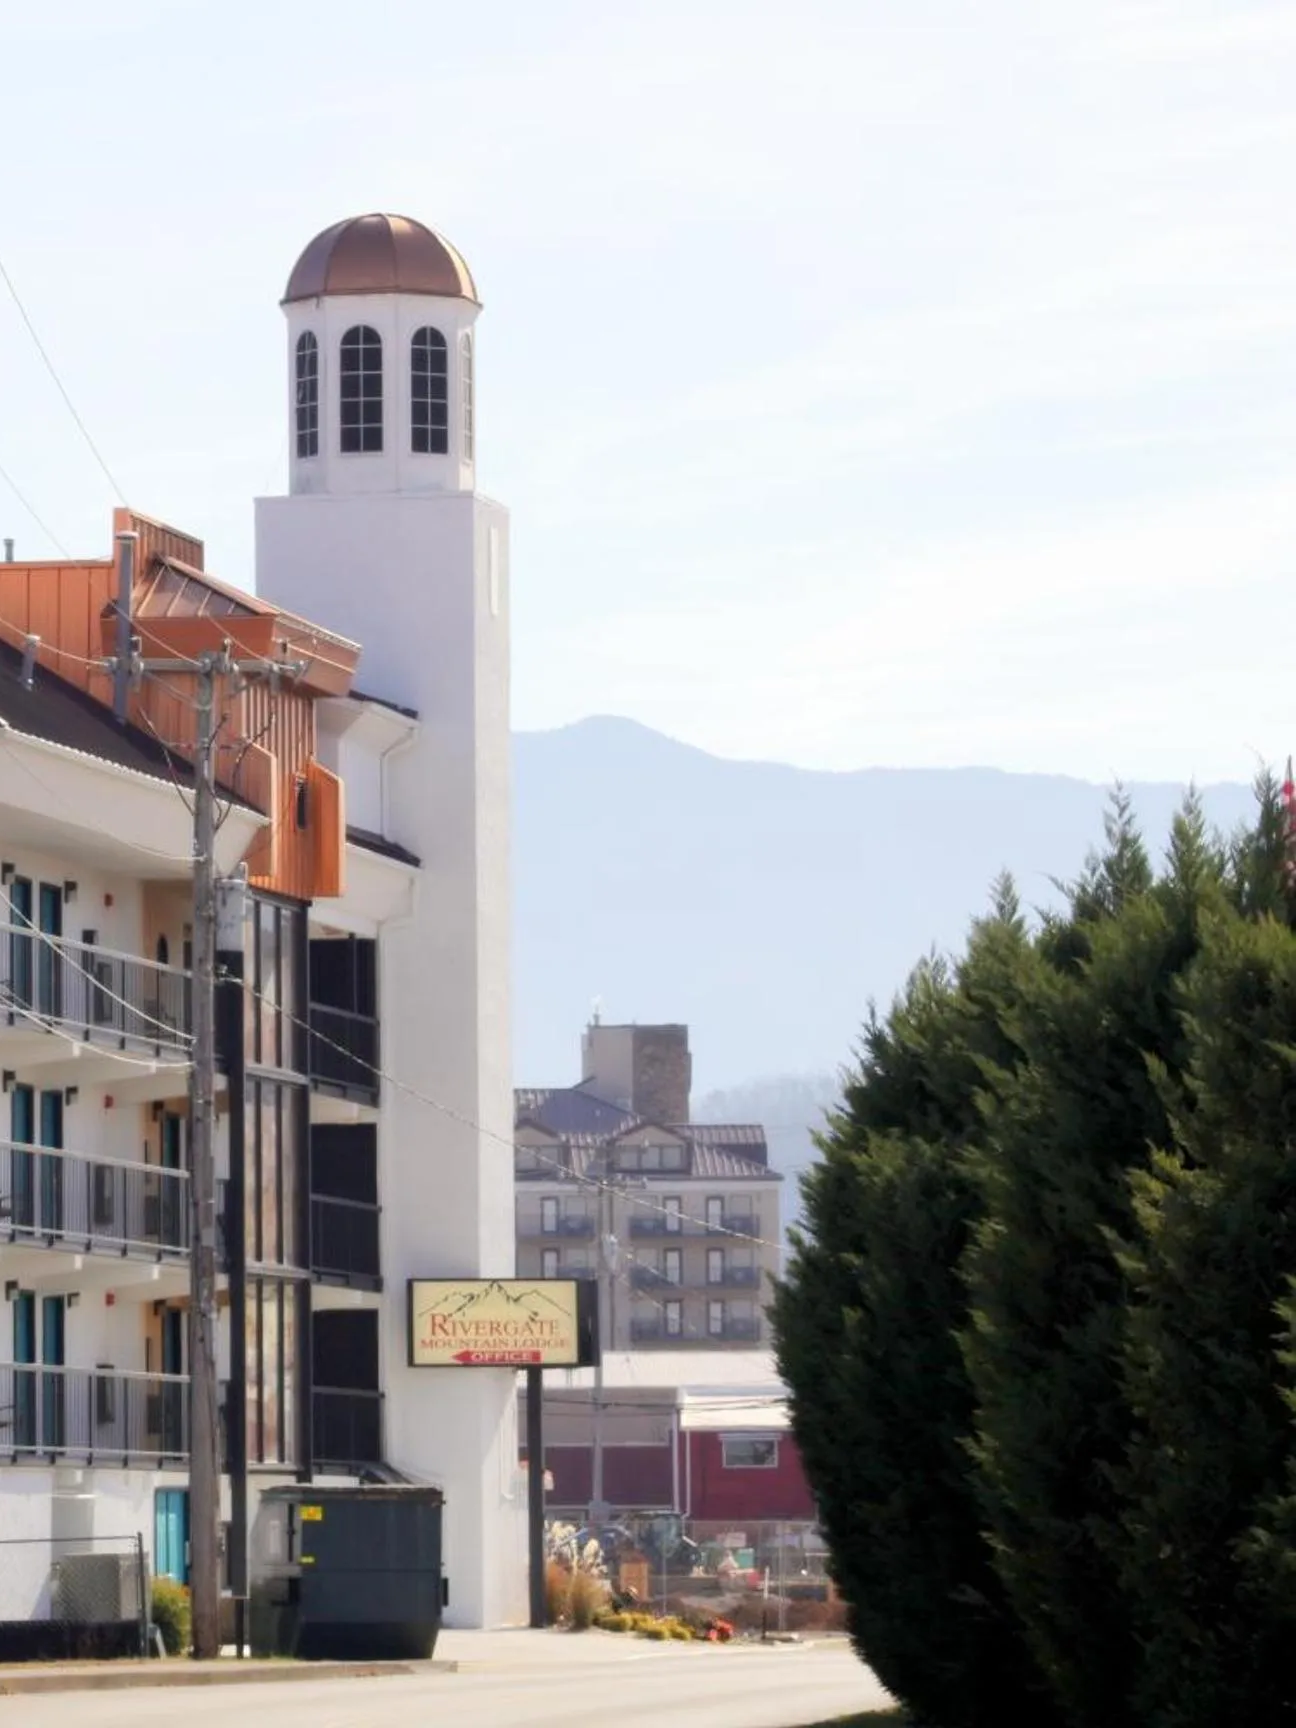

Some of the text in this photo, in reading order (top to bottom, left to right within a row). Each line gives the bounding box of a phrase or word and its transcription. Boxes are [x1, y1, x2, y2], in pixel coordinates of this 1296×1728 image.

[430, 1313, 560, 1336] RIVERGATE
[421, 1338, 566, 1349] MOUNTAIN LODGE
[471, 1351, 532, 1361] OFFICE
